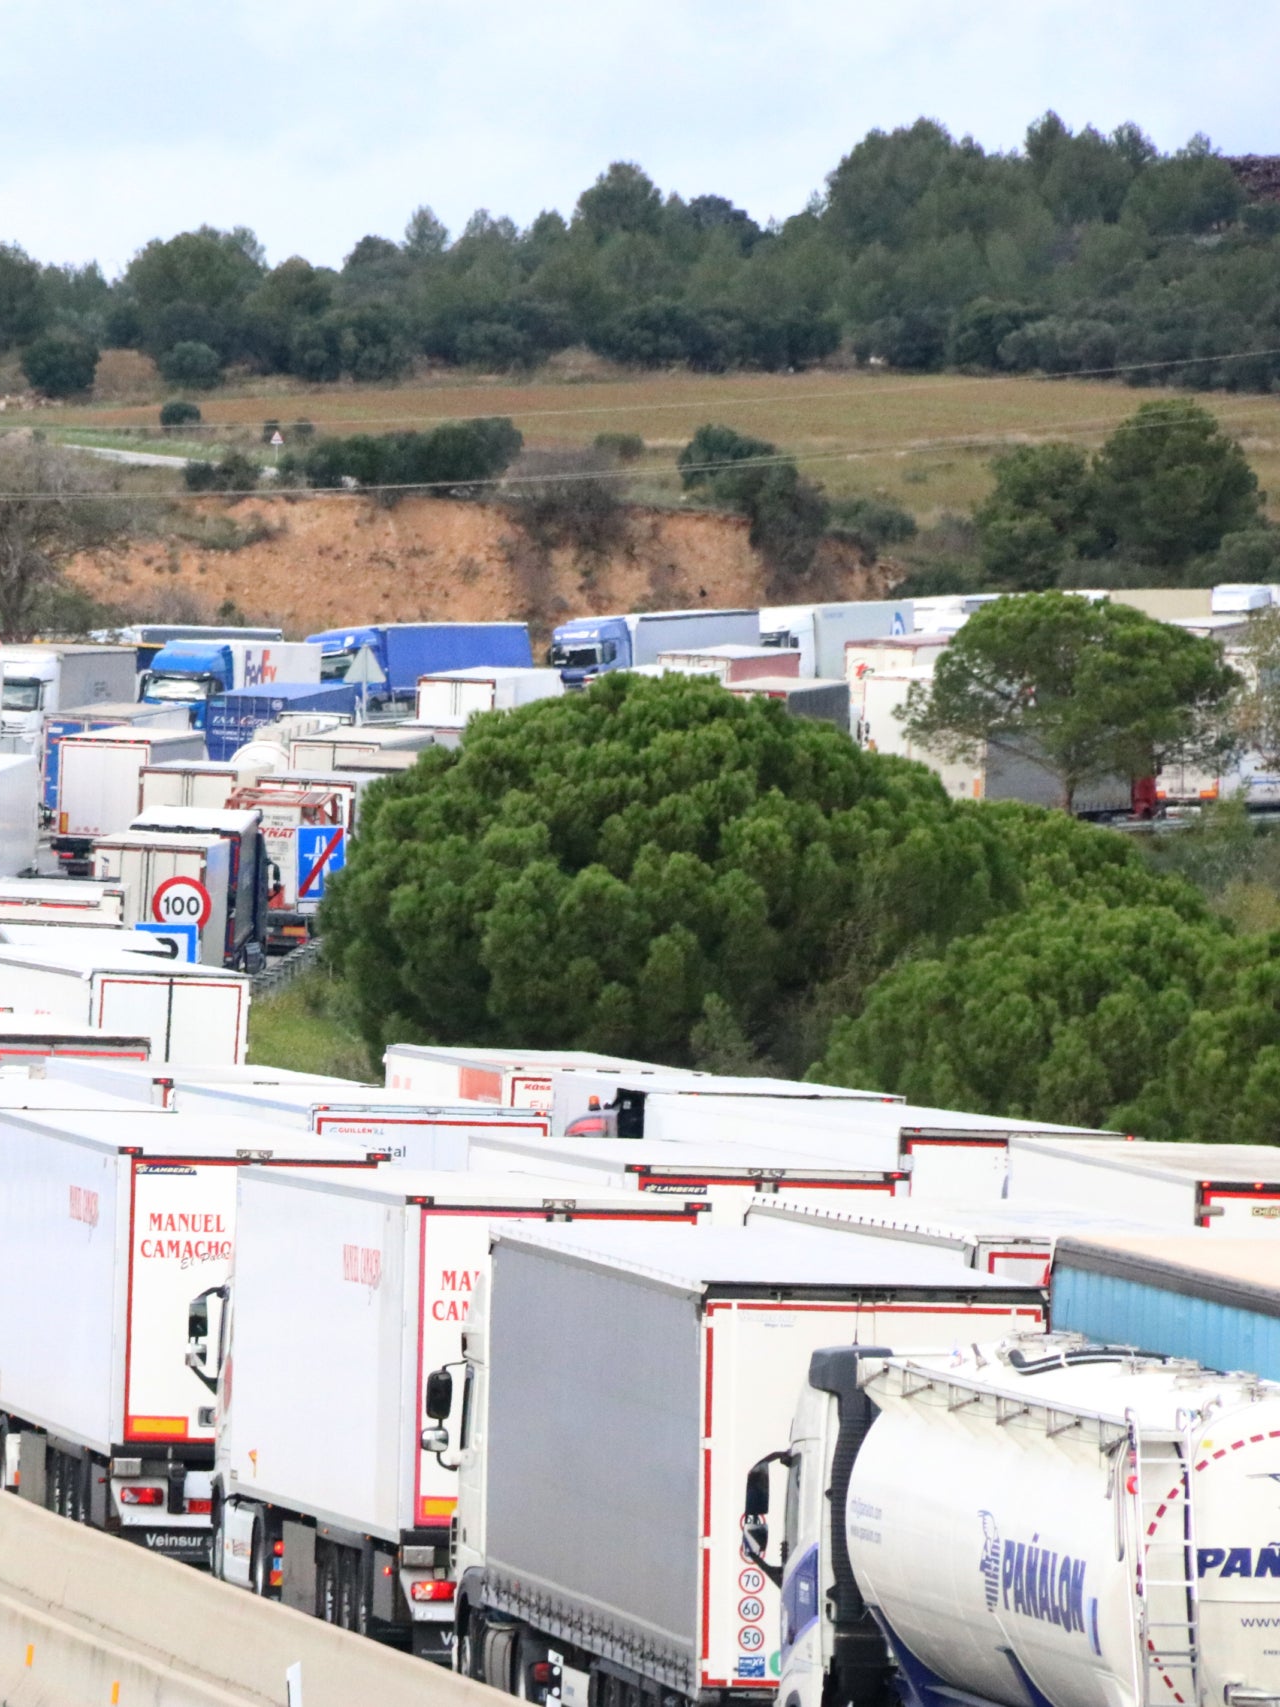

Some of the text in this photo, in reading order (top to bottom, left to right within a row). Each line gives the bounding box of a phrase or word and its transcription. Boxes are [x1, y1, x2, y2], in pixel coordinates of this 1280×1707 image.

[163, 896, 200, 916] 100
[656, 1185, 706, 1193] LAMBERET
[148, 1213, 226, 1233] MANUEL
[140, 1239, 232, 1260] CAMACHO
[146, 1533, 203, 1547] Veinsur
[744, 1575, 760, 1588] 70
[742, 1603, 760, 1616] 60
[742, 1632, 760, 1645] 50
